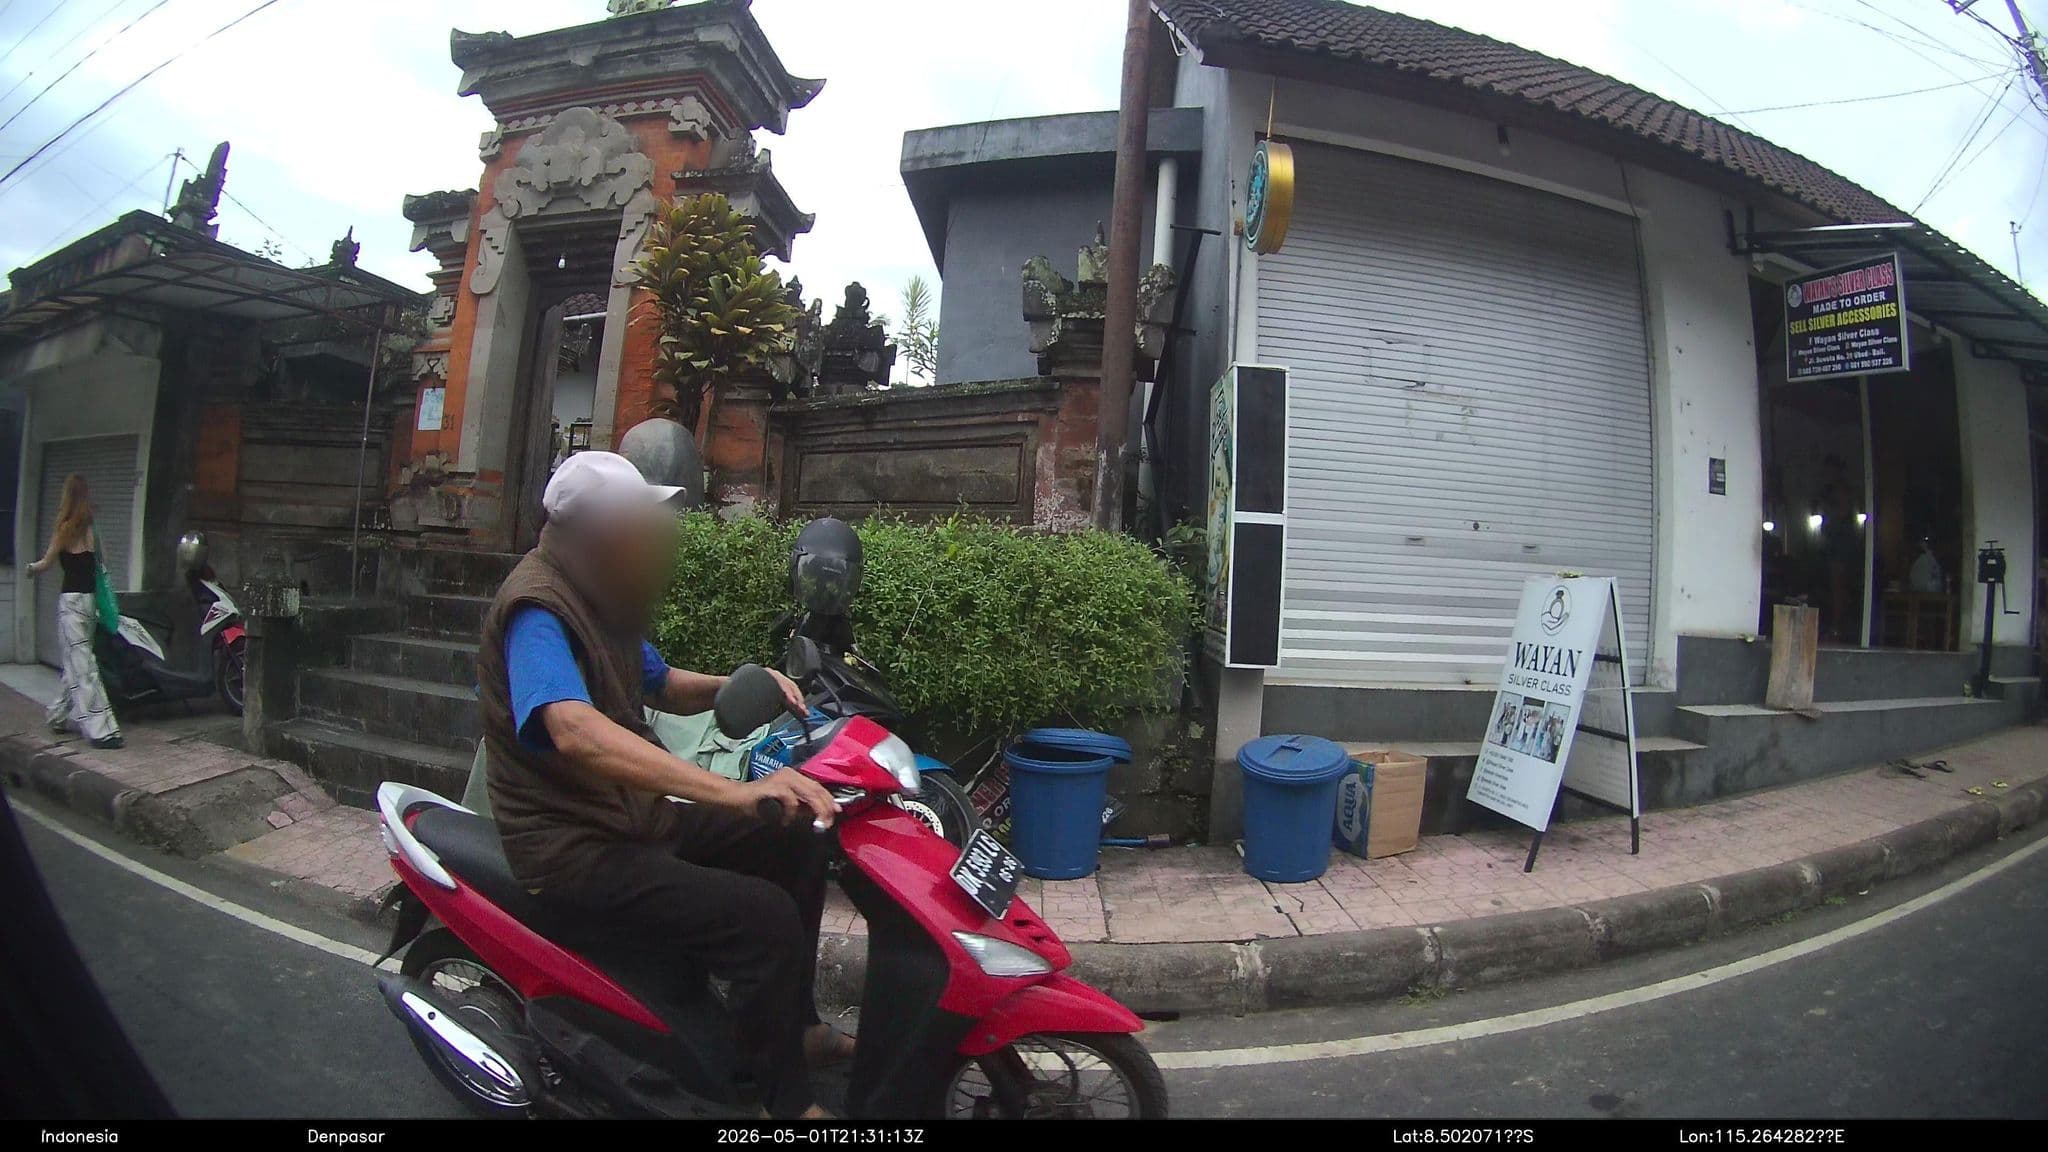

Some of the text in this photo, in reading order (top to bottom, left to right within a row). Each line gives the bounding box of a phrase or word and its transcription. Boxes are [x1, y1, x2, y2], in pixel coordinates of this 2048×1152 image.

[1838, 269, 1866, 296] SILVER
[1866, 262, 1894, 289] CLASS
[1789, 303, 1897, 334] SELL SILVER ACCESSORIES
[1812, 291, 1885, 315] MADE TO ORDER
[1837, 331, 1858, 341] Silver
[1514, 641, 1583, 678] WAYAN
[1507, 673, 1572, 696] SILVER CLASS
[754, 751, 784, 769] YAMAHA
[1342, 781, 1357, 832] AQUA
[956, 865, 984, 896] DK
